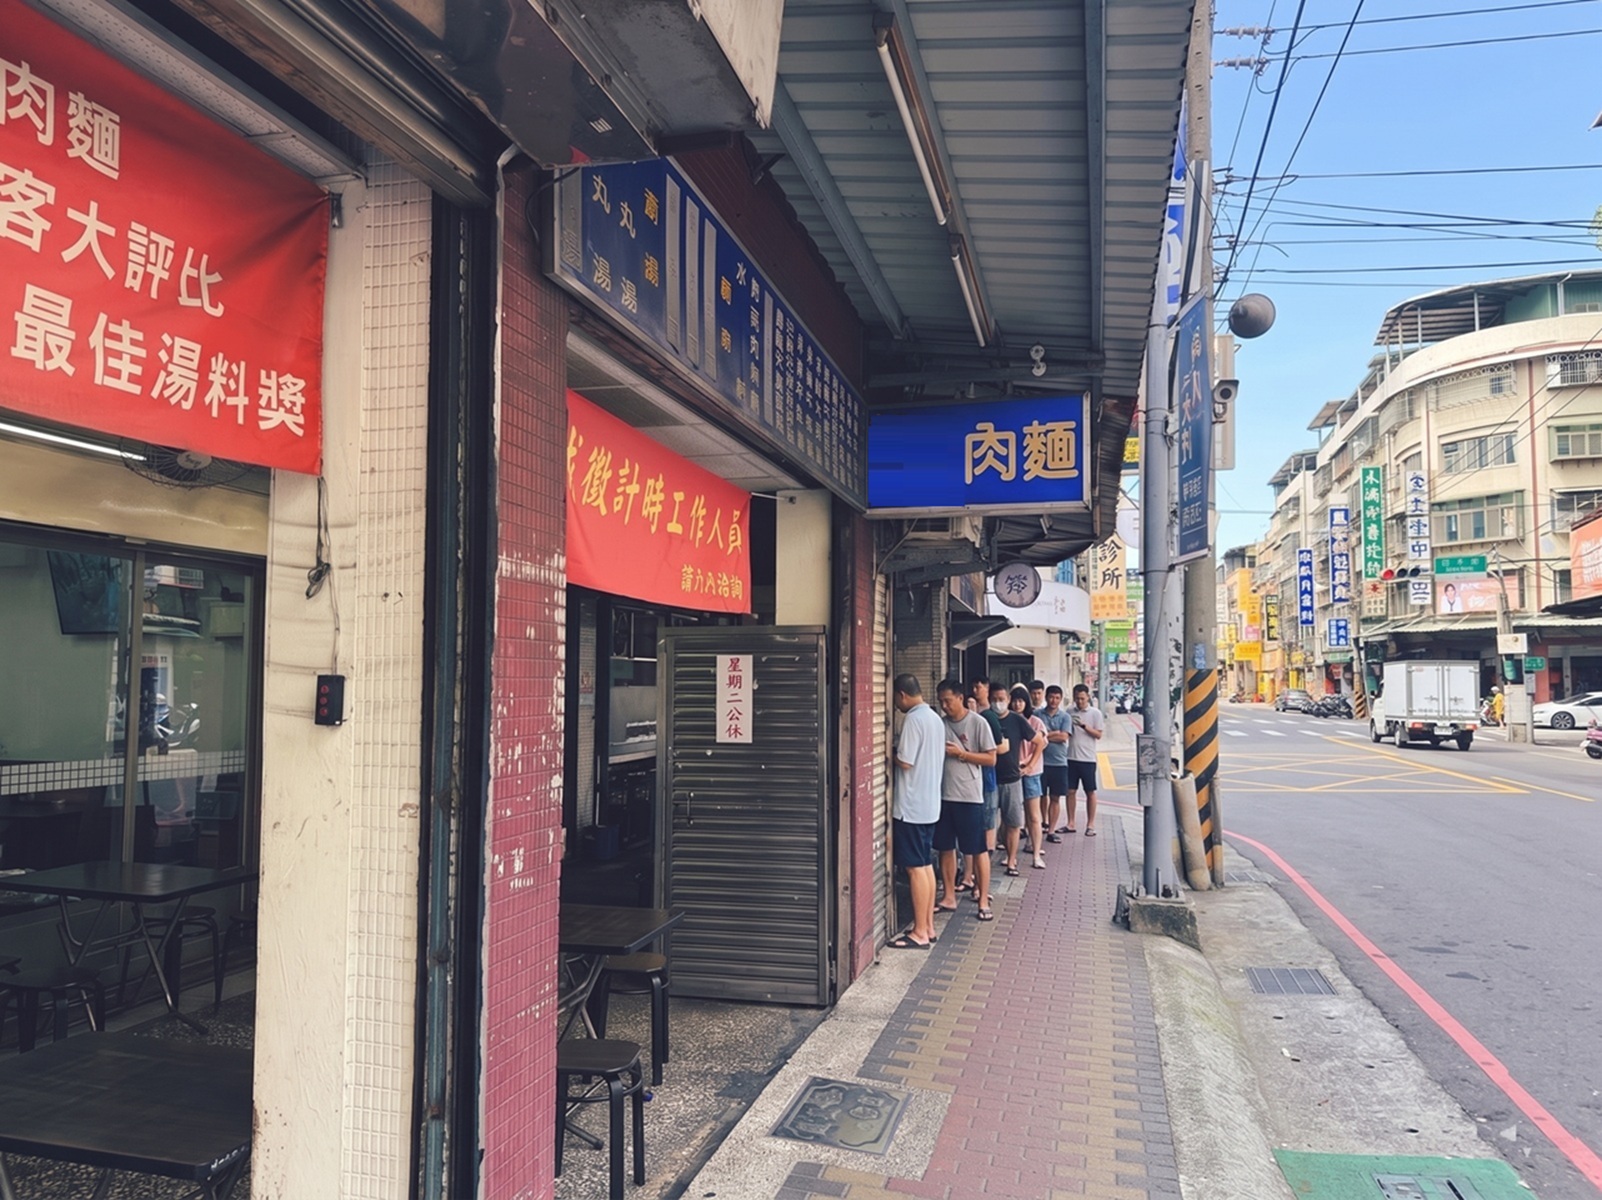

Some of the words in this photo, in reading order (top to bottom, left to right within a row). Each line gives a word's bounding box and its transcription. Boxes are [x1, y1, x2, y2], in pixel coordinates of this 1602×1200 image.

[0, 58, 120, 180] 肉麵
[0, 163, 225, 318] 客大評比
[10, 283, 306, 437] 最佳湯料獎
[964, 420, 1079, 485] 肉麵
[1098, 539, 1123, 590] 診所
[725, 657, 744, 739] 星期二公休
